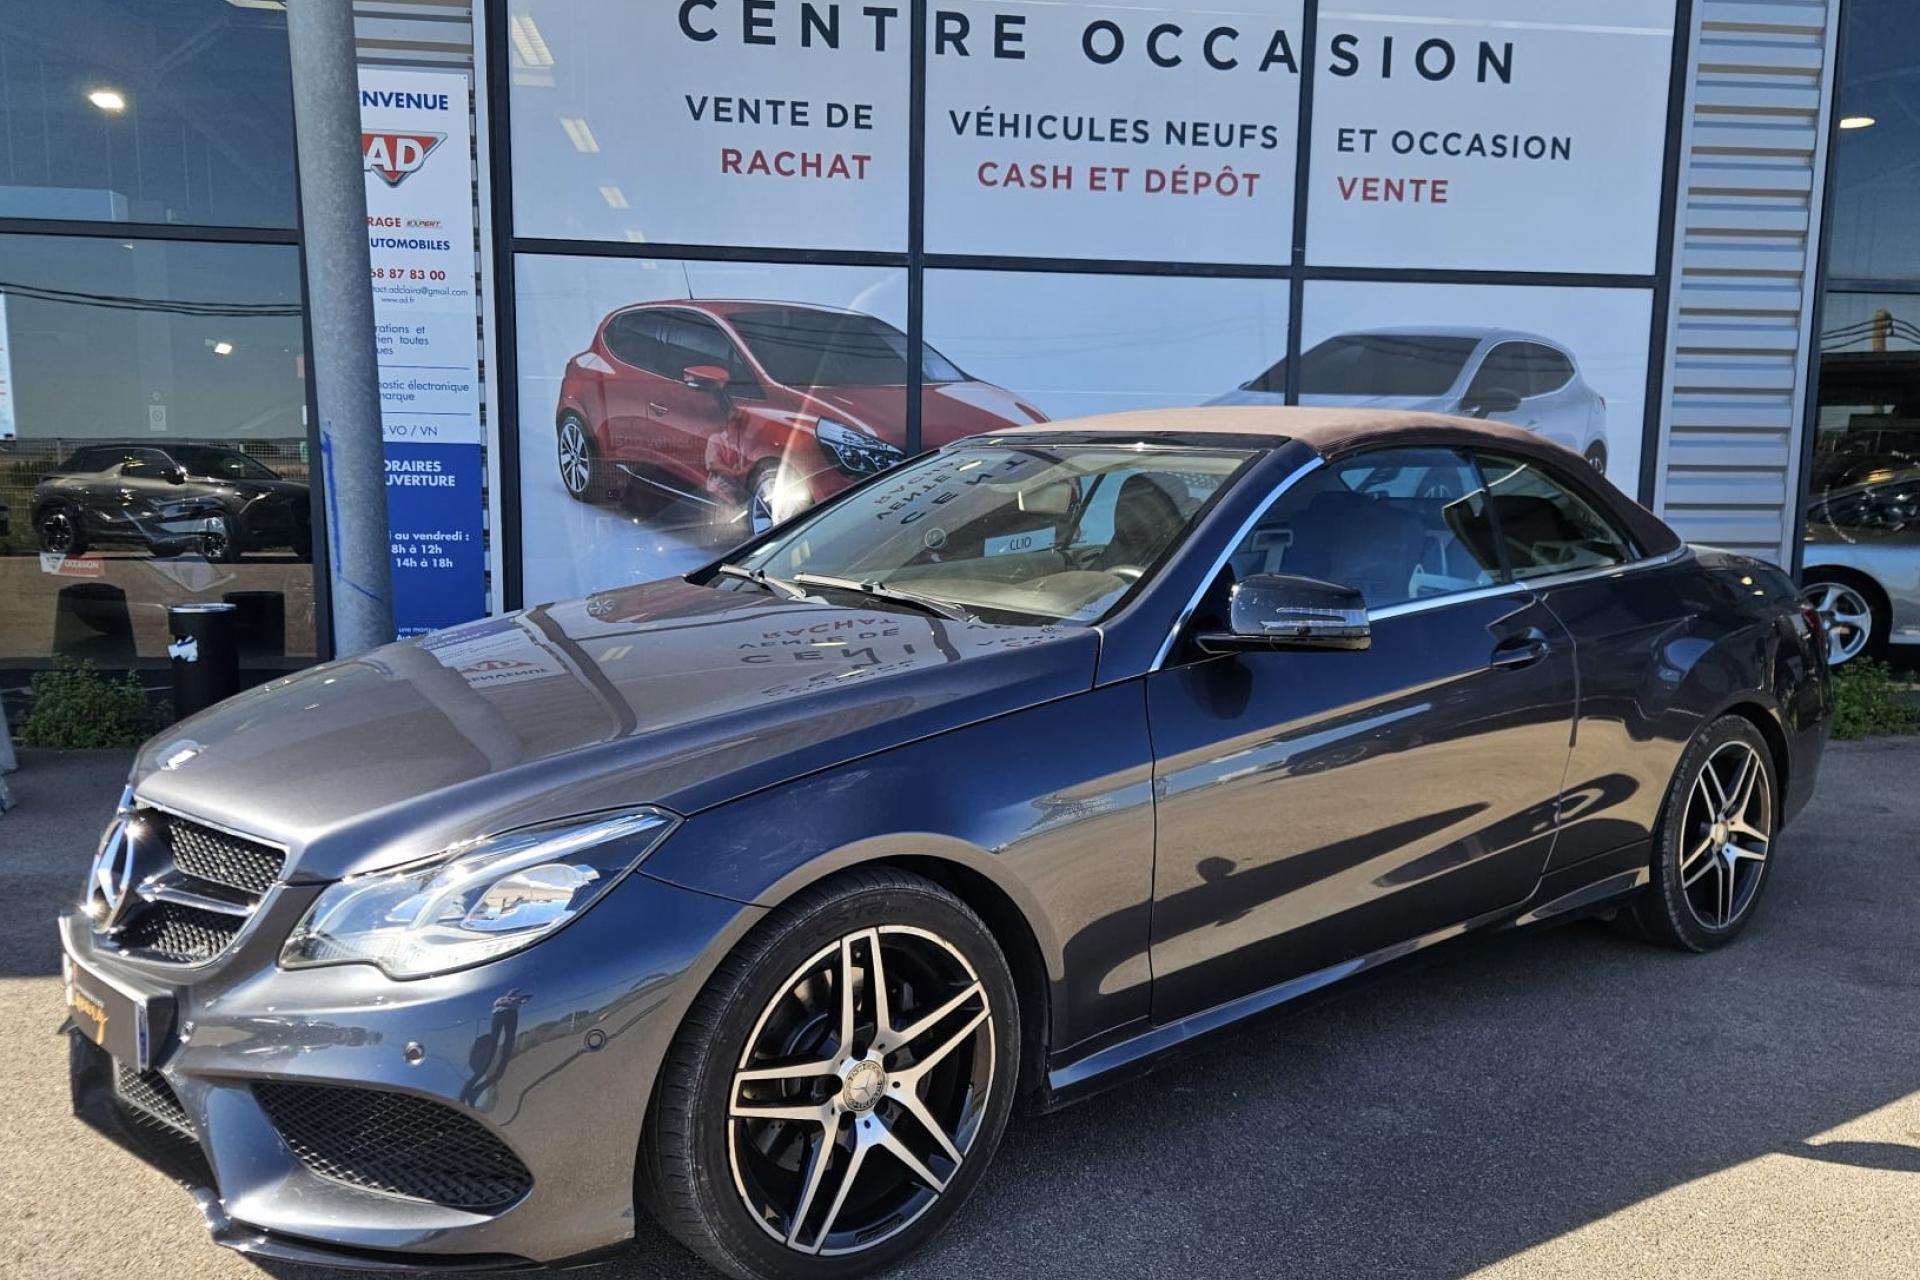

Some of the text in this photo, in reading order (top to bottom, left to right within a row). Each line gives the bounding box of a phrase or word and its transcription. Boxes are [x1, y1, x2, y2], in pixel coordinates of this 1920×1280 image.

[678, 0, 1514, 84] CENTRE OCCASION
[360, 90, 449, 110] NVENUE
[685, 94, 1573, 161] VENTE DE VÉHICULES NEUFS ET OCCASION
[364, 136, 425, 172] AD
[721, 148, 1449, 203] RACHAT CASH ET DÉPÔT VENTE
[366, 216, 401, 228] RAGE
[370, 238, 450, 250] UTOMOBILES
[389, 268, 405, 279] 87
[409, 269, 425, 280] 83
[429, 270, 446, 281] 00
[416, 326, 425, 334] et
[376, 334, 430, 346] ien toutes
[407, 379, 470, 393] électronique
[389, 425, 407, 436] VO
[420, 426, 438, 437] VN
[394, 533, 410, 541] au
[413, 531, 462, 541] vendredi
[391, 544, 406, 554] 8h
[421, 544, 443, 555] 12h
[1010, 536, 1032, 551] CLIO
[396, 557, 418, 568] 14h
[432, 557, 454, 568] 18h
